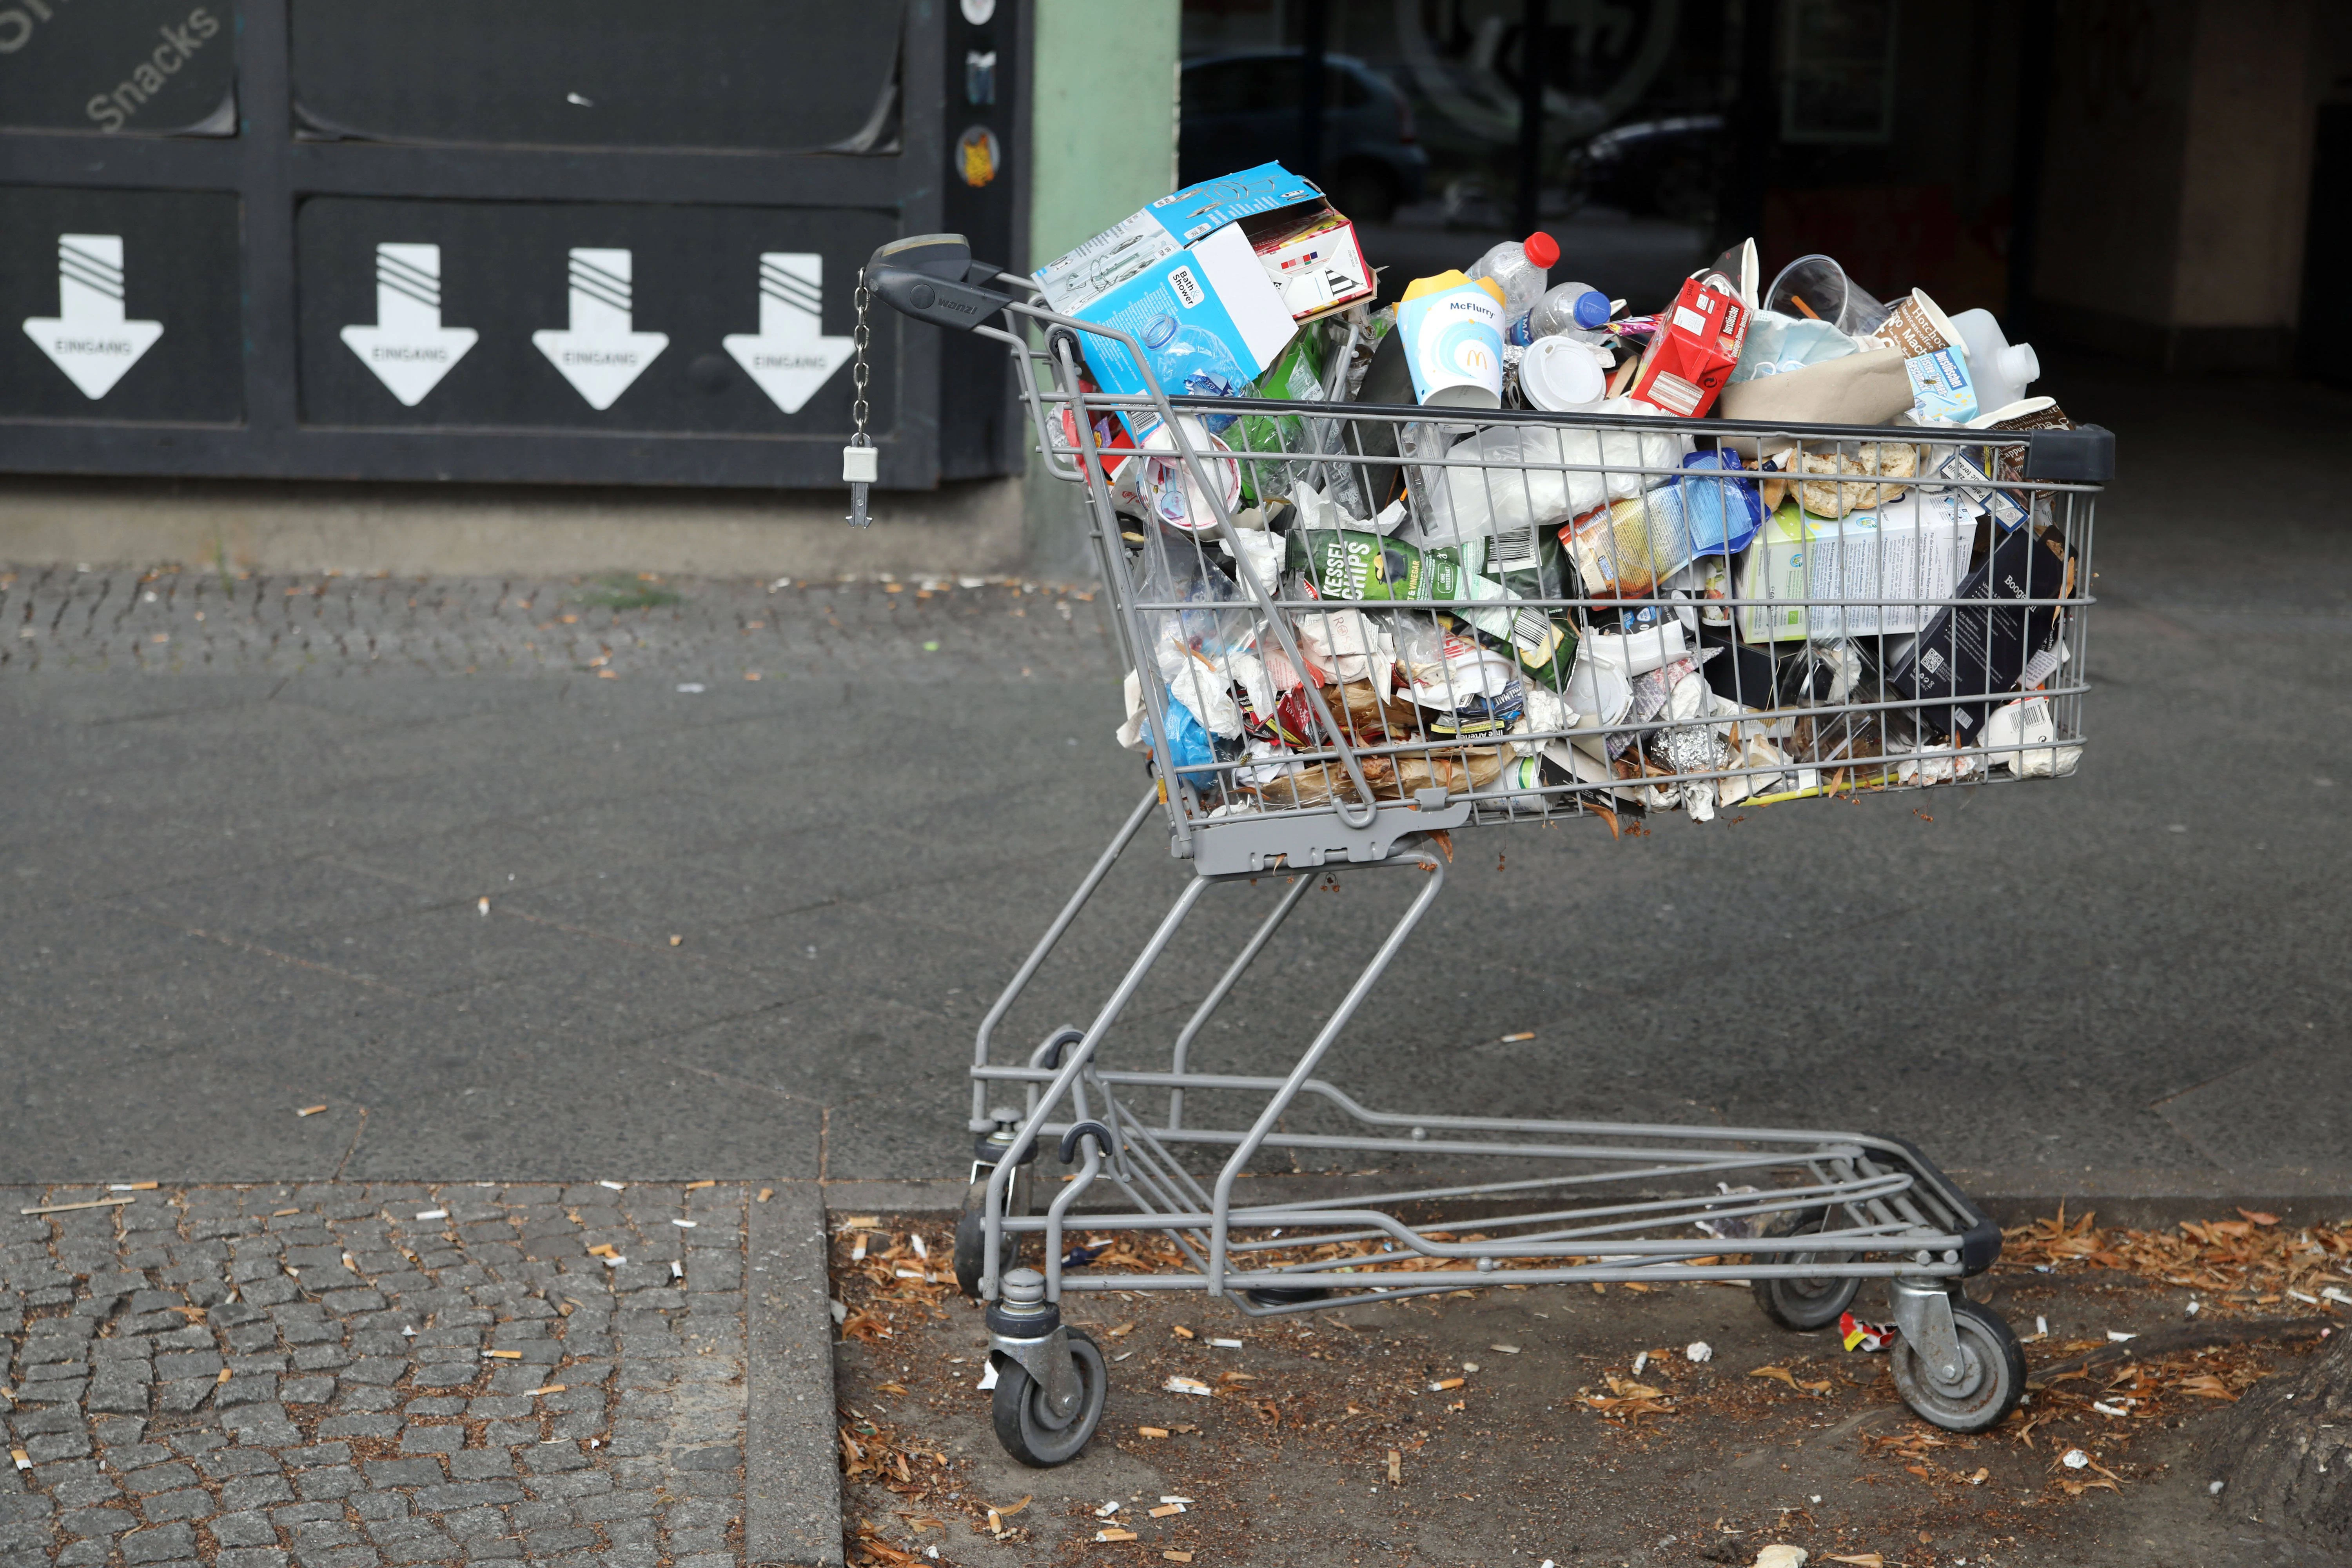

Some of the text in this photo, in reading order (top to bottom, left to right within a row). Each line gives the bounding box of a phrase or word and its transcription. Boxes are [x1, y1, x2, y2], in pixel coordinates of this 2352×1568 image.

[86, 6, 220, 134] Snacks
[1172, 273, 1195, 305] Shower
[1179, 270, 1202, 299] Bath &
[938, 298, 978, 315] wanzl
[1450, 302, 1494, 319] McFlurry
[1720, 305, 1742, 335] Durstlöscher
[1900, 305, 1935, 350] Americancoffee
[1911, 306, 1947, 350] Hotchoc
[55, 340, 131, 355] EINGANG
[373, 347, 449, 363] EINGANG
[1901, 327, 1929, 359] Mach
[563, 350, 638, 366] EINGANG
[753, 354, 828, 370] EINGANG
[1919, 354, 1937, 375] Eistee
[1935, 349, 1964, 388] Durstlöscher
[1998, 445, 2025, 460] Cappuc
[1321, 539, 1348, 597] KESSEL
[1341, 540, 1370, 601] CHIPS
[1408, 560, 1420, 590] VINEGAR
[1965, 617, 1980, 632] features:
[1935, 670, 1947, 682] Germany
